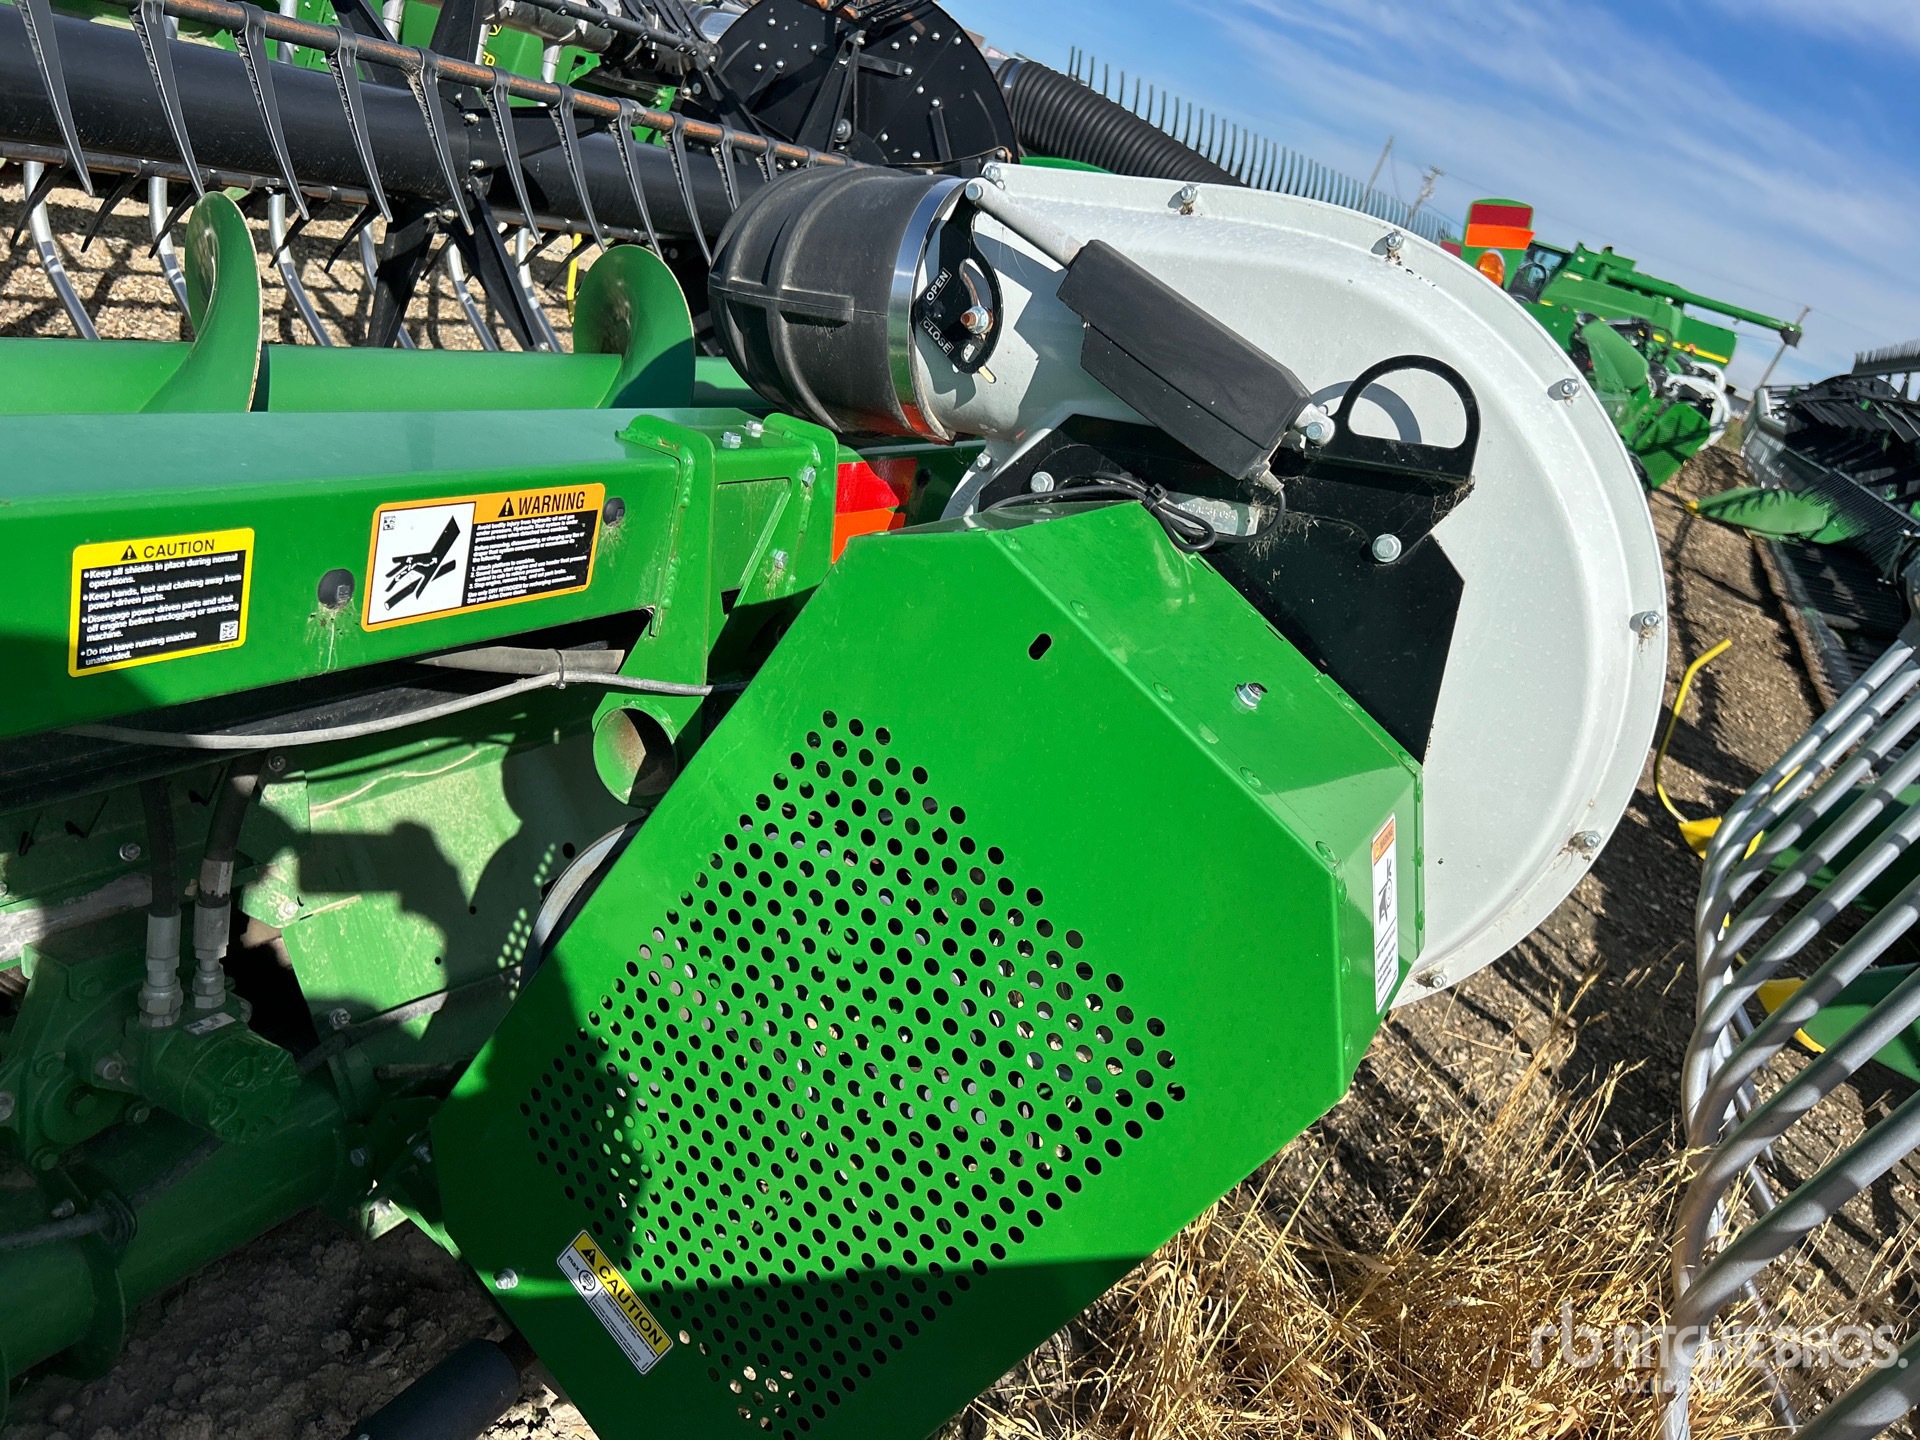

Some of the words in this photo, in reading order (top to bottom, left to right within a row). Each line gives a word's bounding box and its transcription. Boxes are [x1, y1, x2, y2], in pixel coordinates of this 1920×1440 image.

[926, 270, 949, 301] OPEN
[923, 320, 951, 353] CLOSE
[518, 491, 586, 515] WARNING
[143, 538, 216, 559] CAUTION
[89, 569, 111, 578] Keep
[112, 566, 123, 576] all
[124, 563, 153, 574] shields
[154, 562, 163, 570] in
[163, 560, 185, 570] place
[185, 557, 211, 566] during
[211, 552, 238, 563] normal
[88, 576, 135, 588] operations.
[88, 591, 110, 601] Keep
[139, 584, 155, 594] feet
[156, 582, 172, 591] and
[172, 579, 204, 589] clothing
[204, 576, 223, 585] away
[224, 573, 241, 582] from
[87, 611, 130, 623] Disengage
[181, 600, 201, 610] parts
[201, 596, 216, 606] and
[86, 623, 99, 632] off
[99, 620, 127, 630] engine
[128, 616, 153, 626] before
[86, 630, 123, 642] machine.
[86, 648, 98, 656] Do
[98, 644, 112, 654] not
[113, 642, 134, 651] leave
[134, 637, 165, 648] running
[165, 631, 197, 642] machine
[85, 650, 131, 665] unattended.
[566, 1255, 580, 1272] max
[599, 1265, 662, 1346] CAUTION
